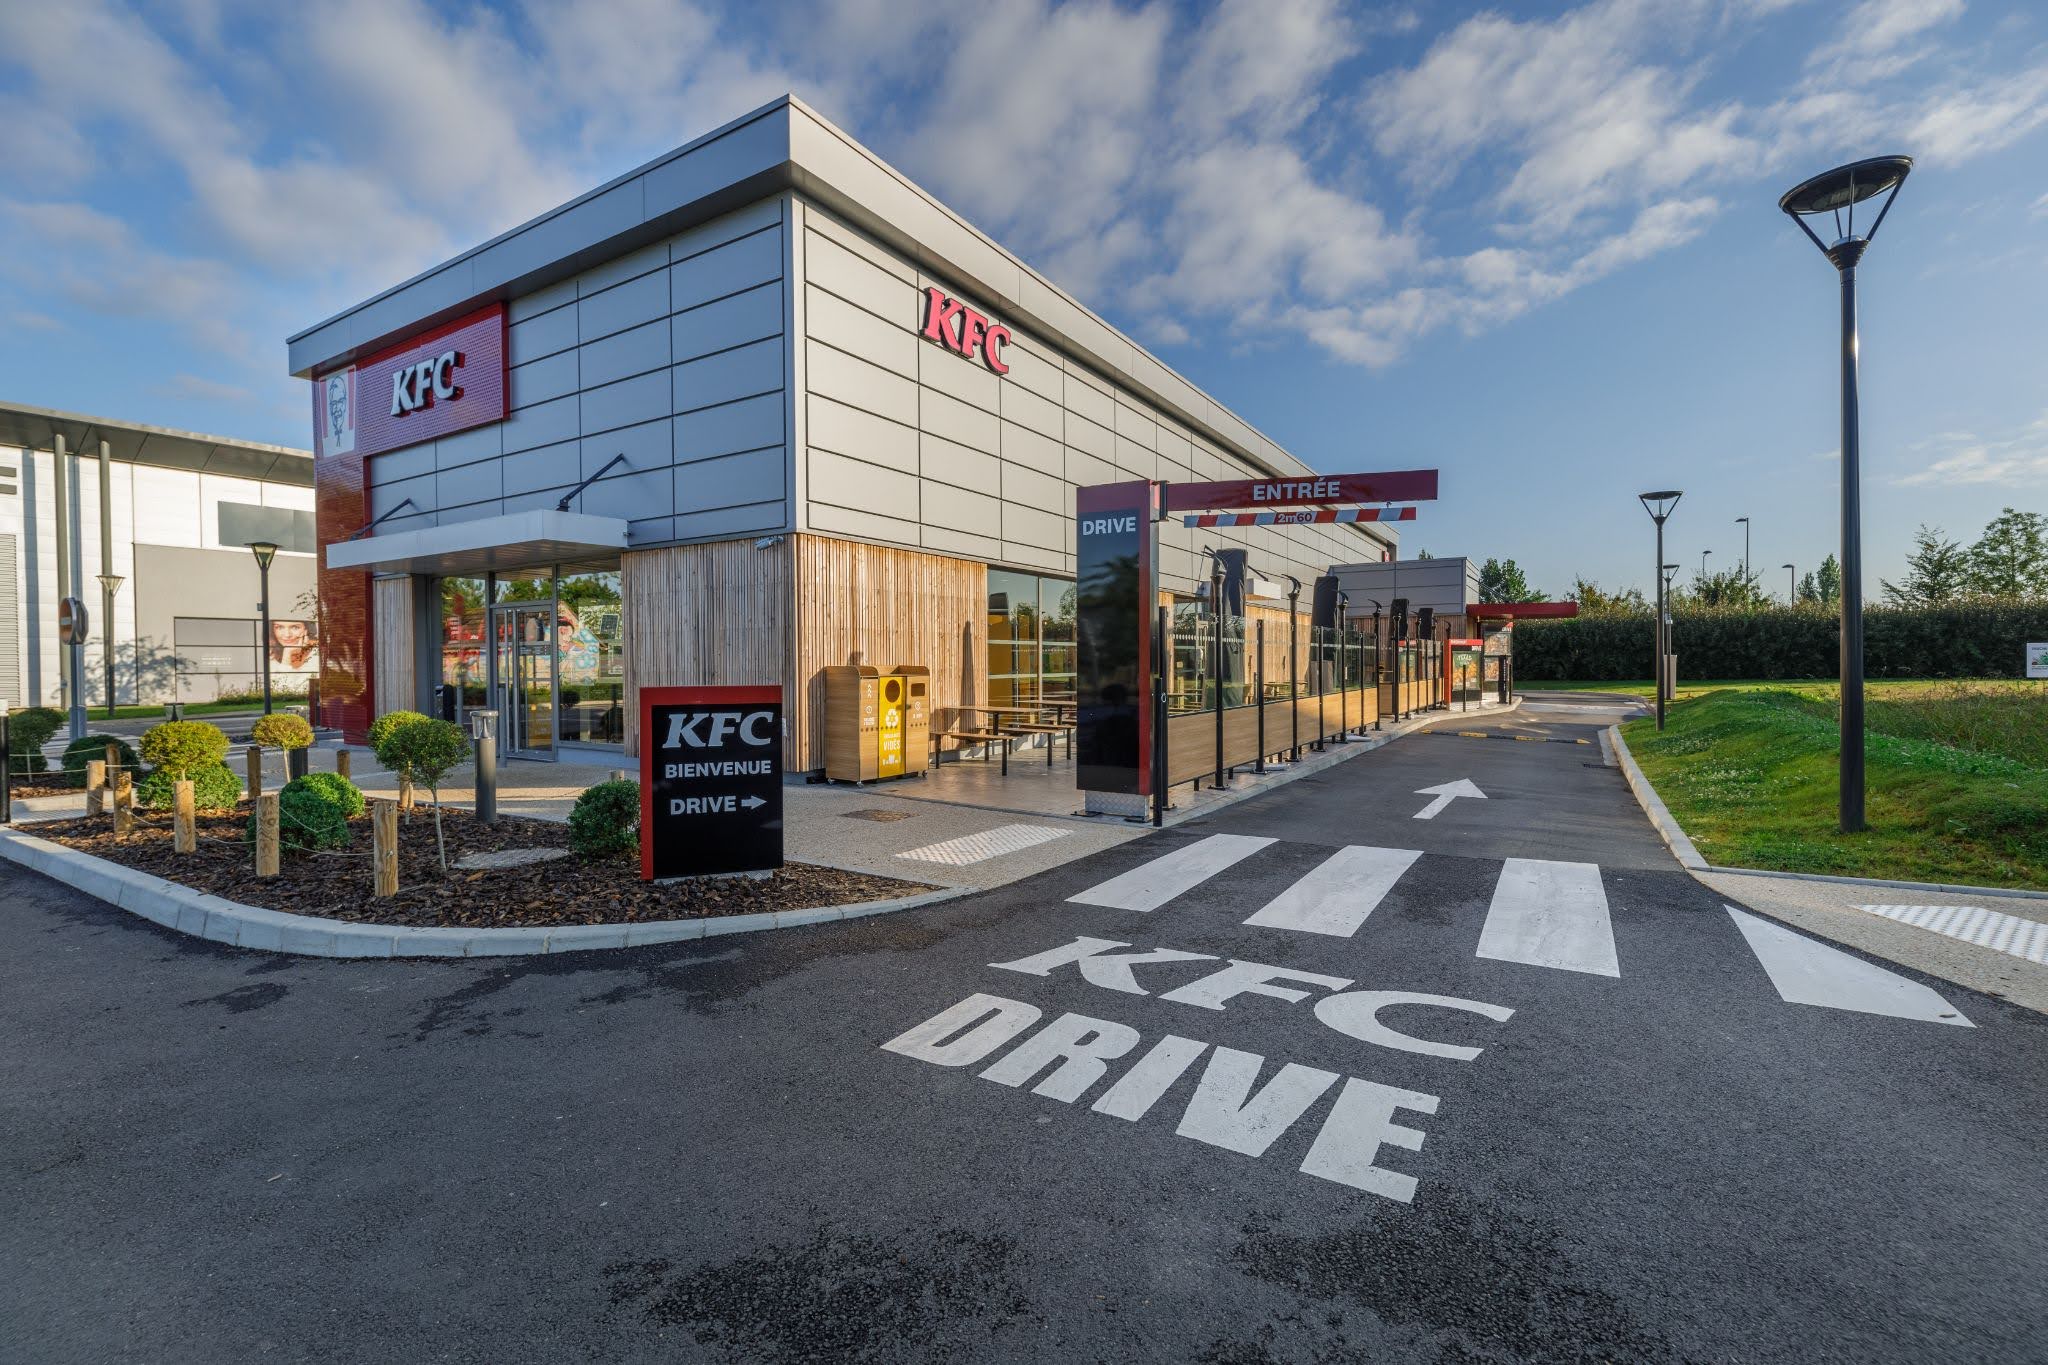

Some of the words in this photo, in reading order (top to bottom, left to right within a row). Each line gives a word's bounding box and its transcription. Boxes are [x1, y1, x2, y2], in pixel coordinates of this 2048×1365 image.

[921, 286, 1012, 375] KFC
[391, 351, 458, 416] KFC
[1253, 477, 1340, 501] ENTRÉE
[1082, 516, 1137, 536] DRIVE
[1277, 512, 1313, 524] 2m60
[662, 711, 774, 749] KFC
[665, 760, 772, 780] BIENVENUE
[670, 795, 737, 816] DRIVE
[986, 935, 1516, 1061] KFC
[880, 992, 1441, 1204] DRIVE
